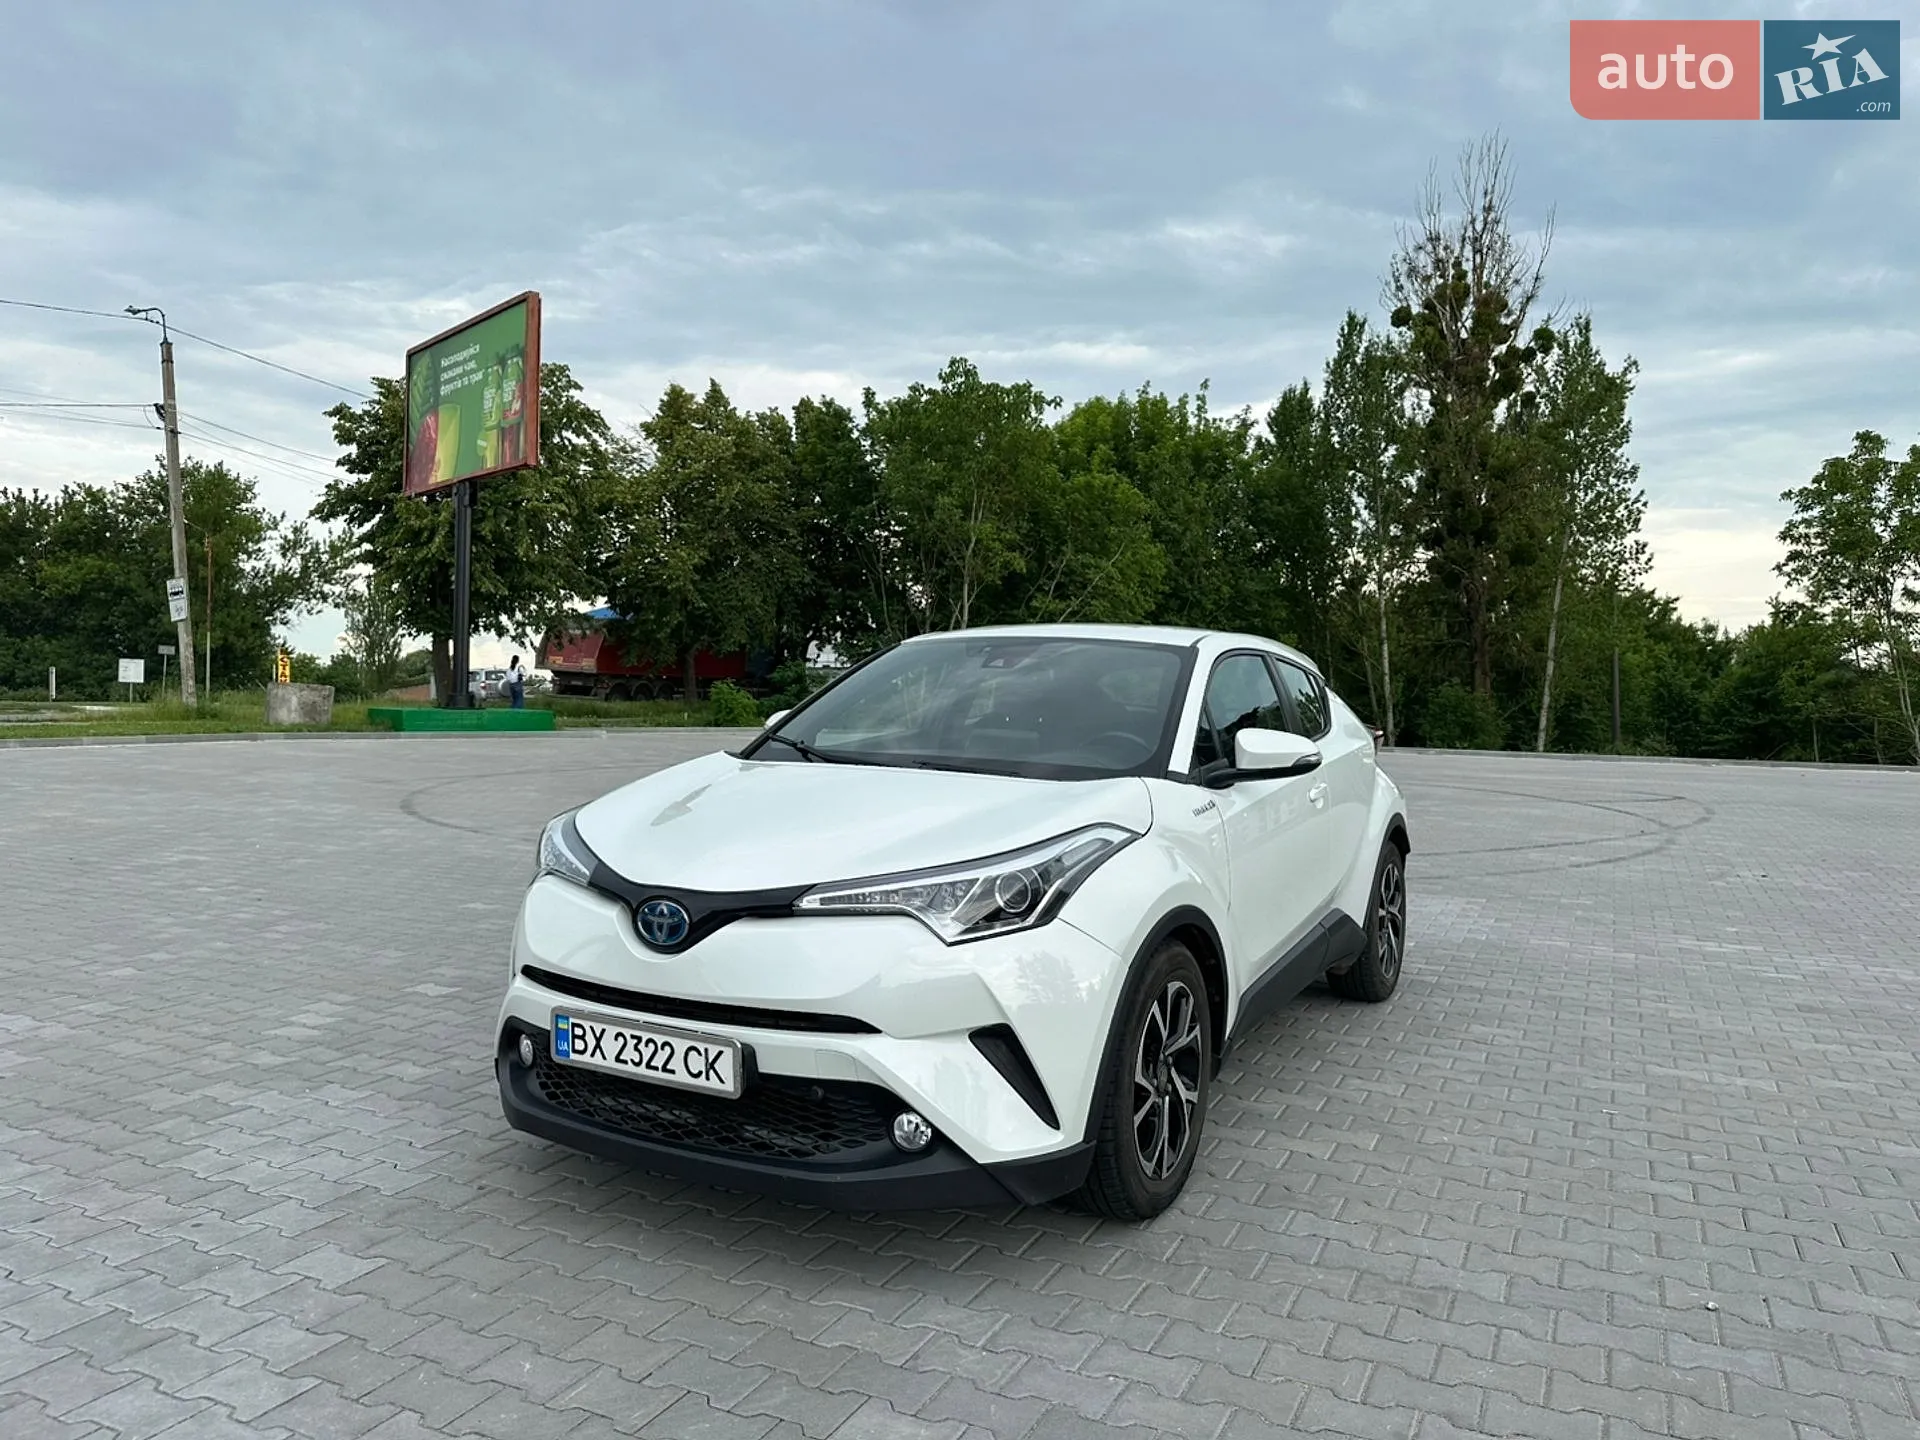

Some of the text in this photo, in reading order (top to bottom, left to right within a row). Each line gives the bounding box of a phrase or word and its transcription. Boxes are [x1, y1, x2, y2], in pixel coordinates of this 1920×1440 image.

[557, 1039, 569, 1052] UA
[571, 1022, 726, 1085] BX 2322 CK
